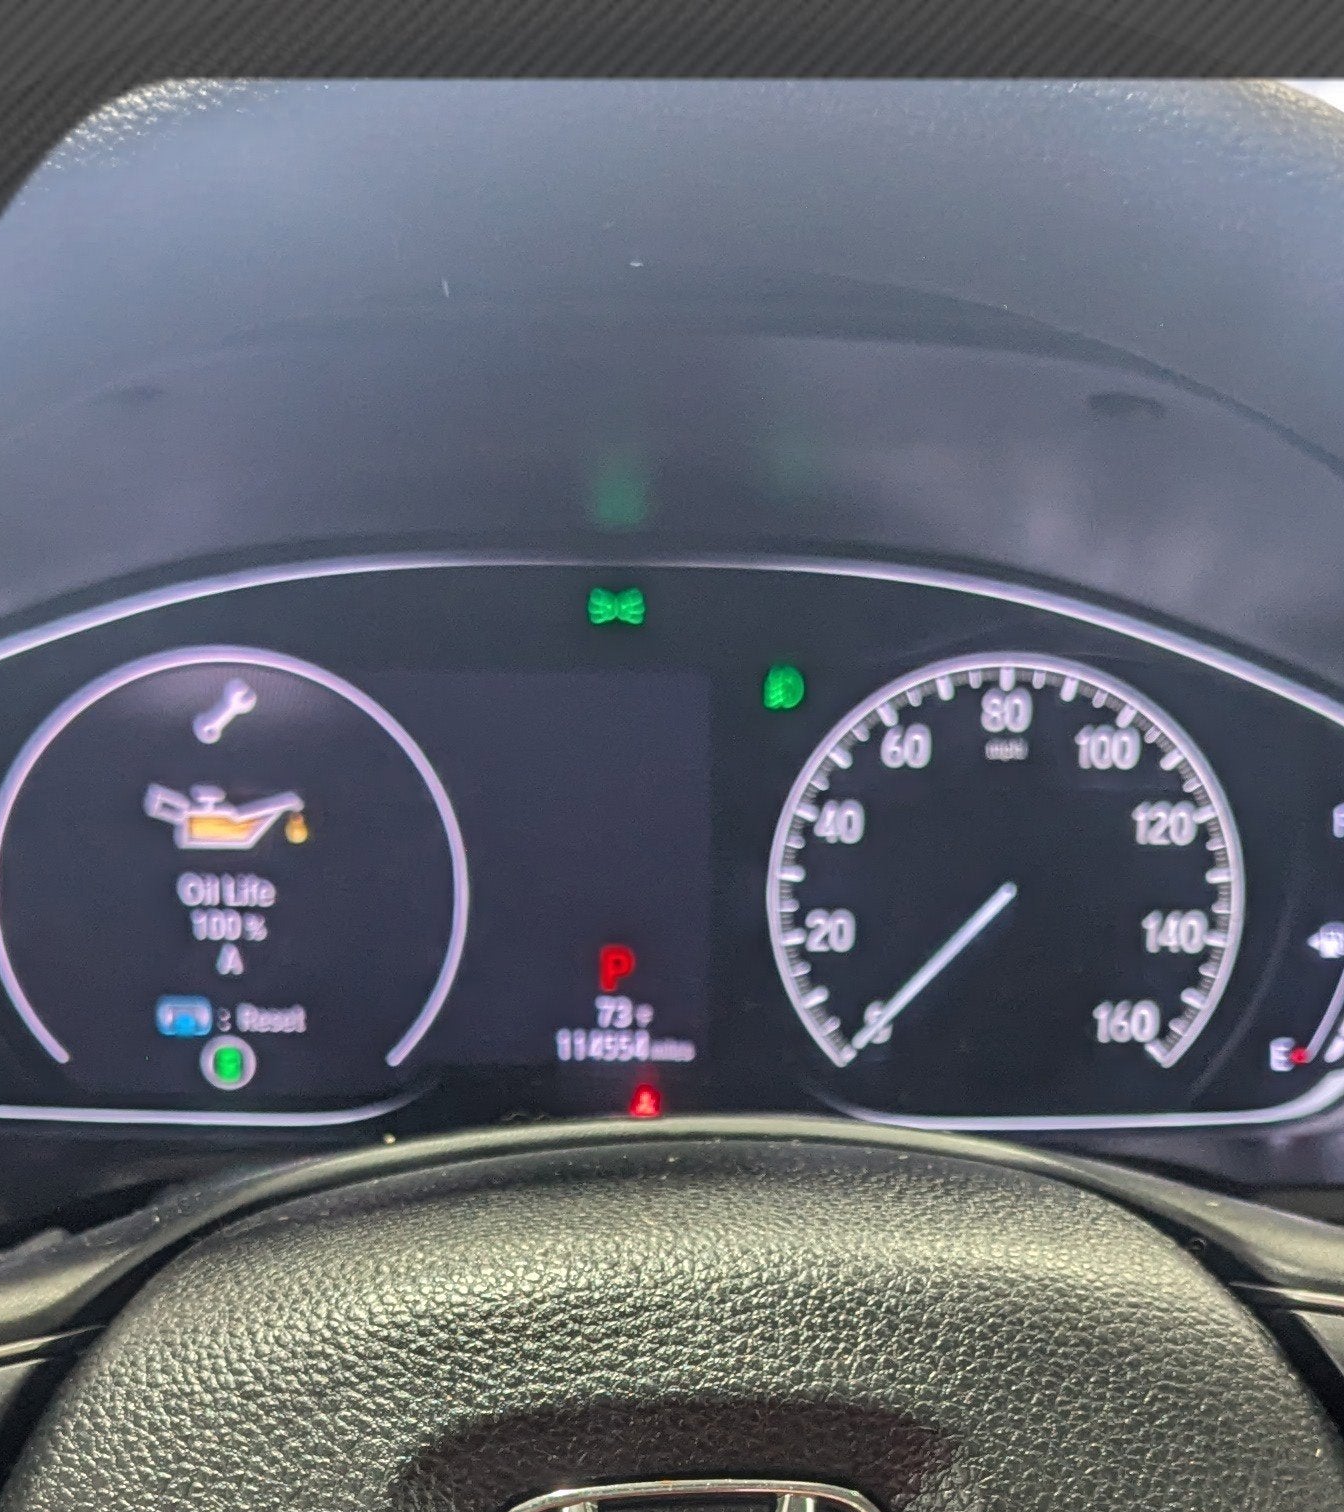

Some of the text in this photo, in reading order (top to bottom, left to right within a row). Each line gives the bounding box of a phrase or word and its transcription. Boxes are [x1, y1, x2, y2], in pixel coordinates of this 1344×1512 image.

[981, 687, 1032, 733] 80
[880, 724, 931, 769] 60
[1075, 725, 1141, 770] 100
[813, 800, 865, 845] 40
[1132, 800, 1197, 845] 120
[177, 872, 277, 908] Oil Life
[805, 909, 856, 952] 20
[1141, 910, 1207, 953] 140
[216, 942, 244, 976] A
[600, 944, 635, 991] P
[595, 995, 633, 1028] 73
[1092, 1001, 1159, 1045] 160
